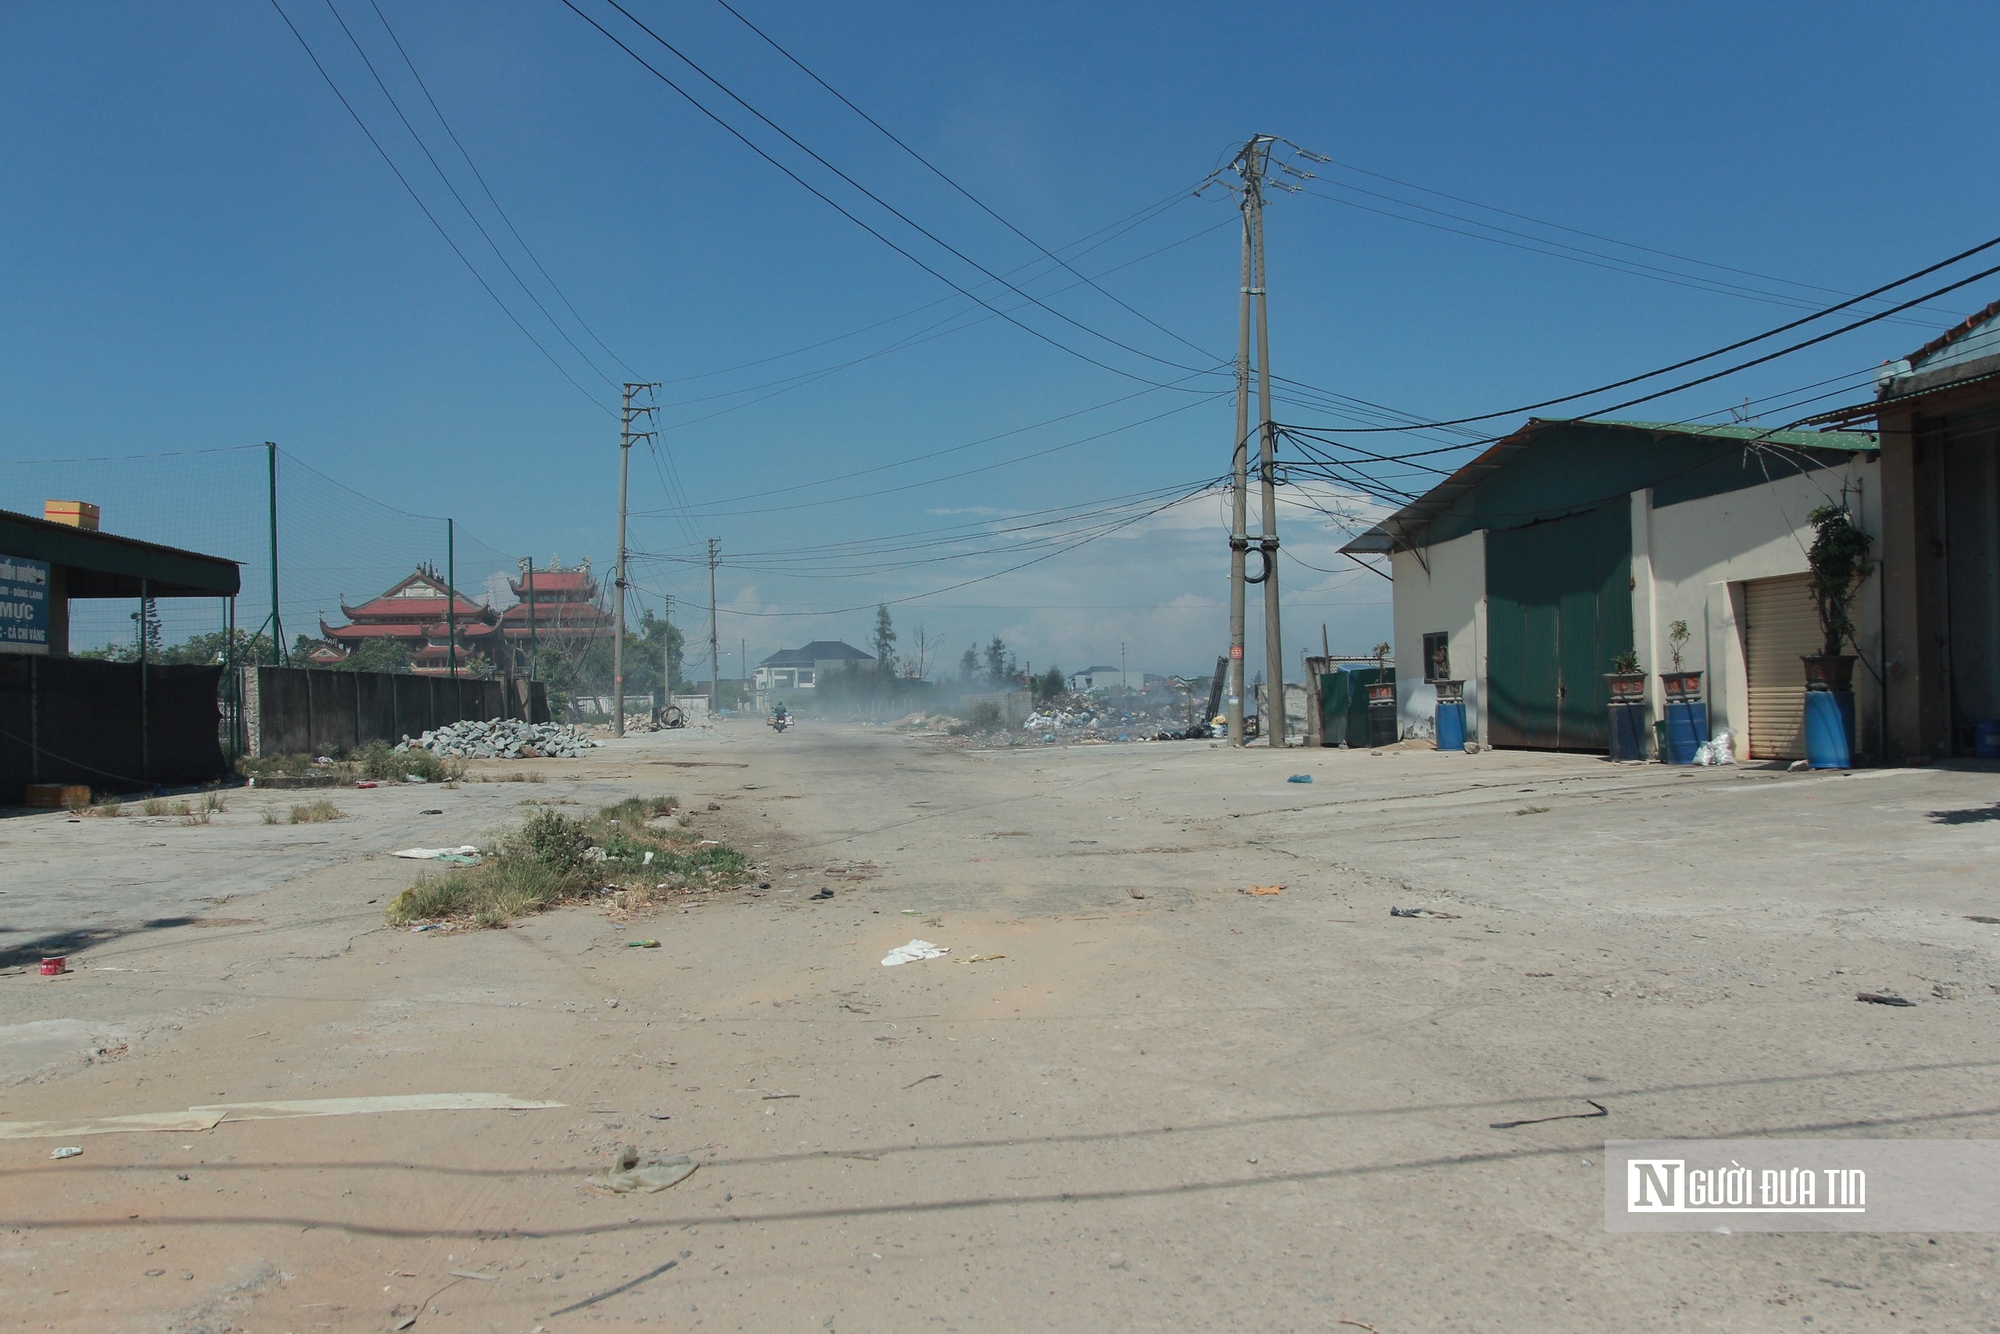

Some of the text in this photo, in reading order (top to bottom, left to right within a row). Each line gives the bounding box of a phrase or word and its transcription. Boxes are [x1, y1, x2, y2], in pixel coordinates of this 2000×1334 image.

[0, 601, 34, 622] MỰC
[8, 625, 17, 639] CÁ
[29, 627, 45, 641] VÀNG
